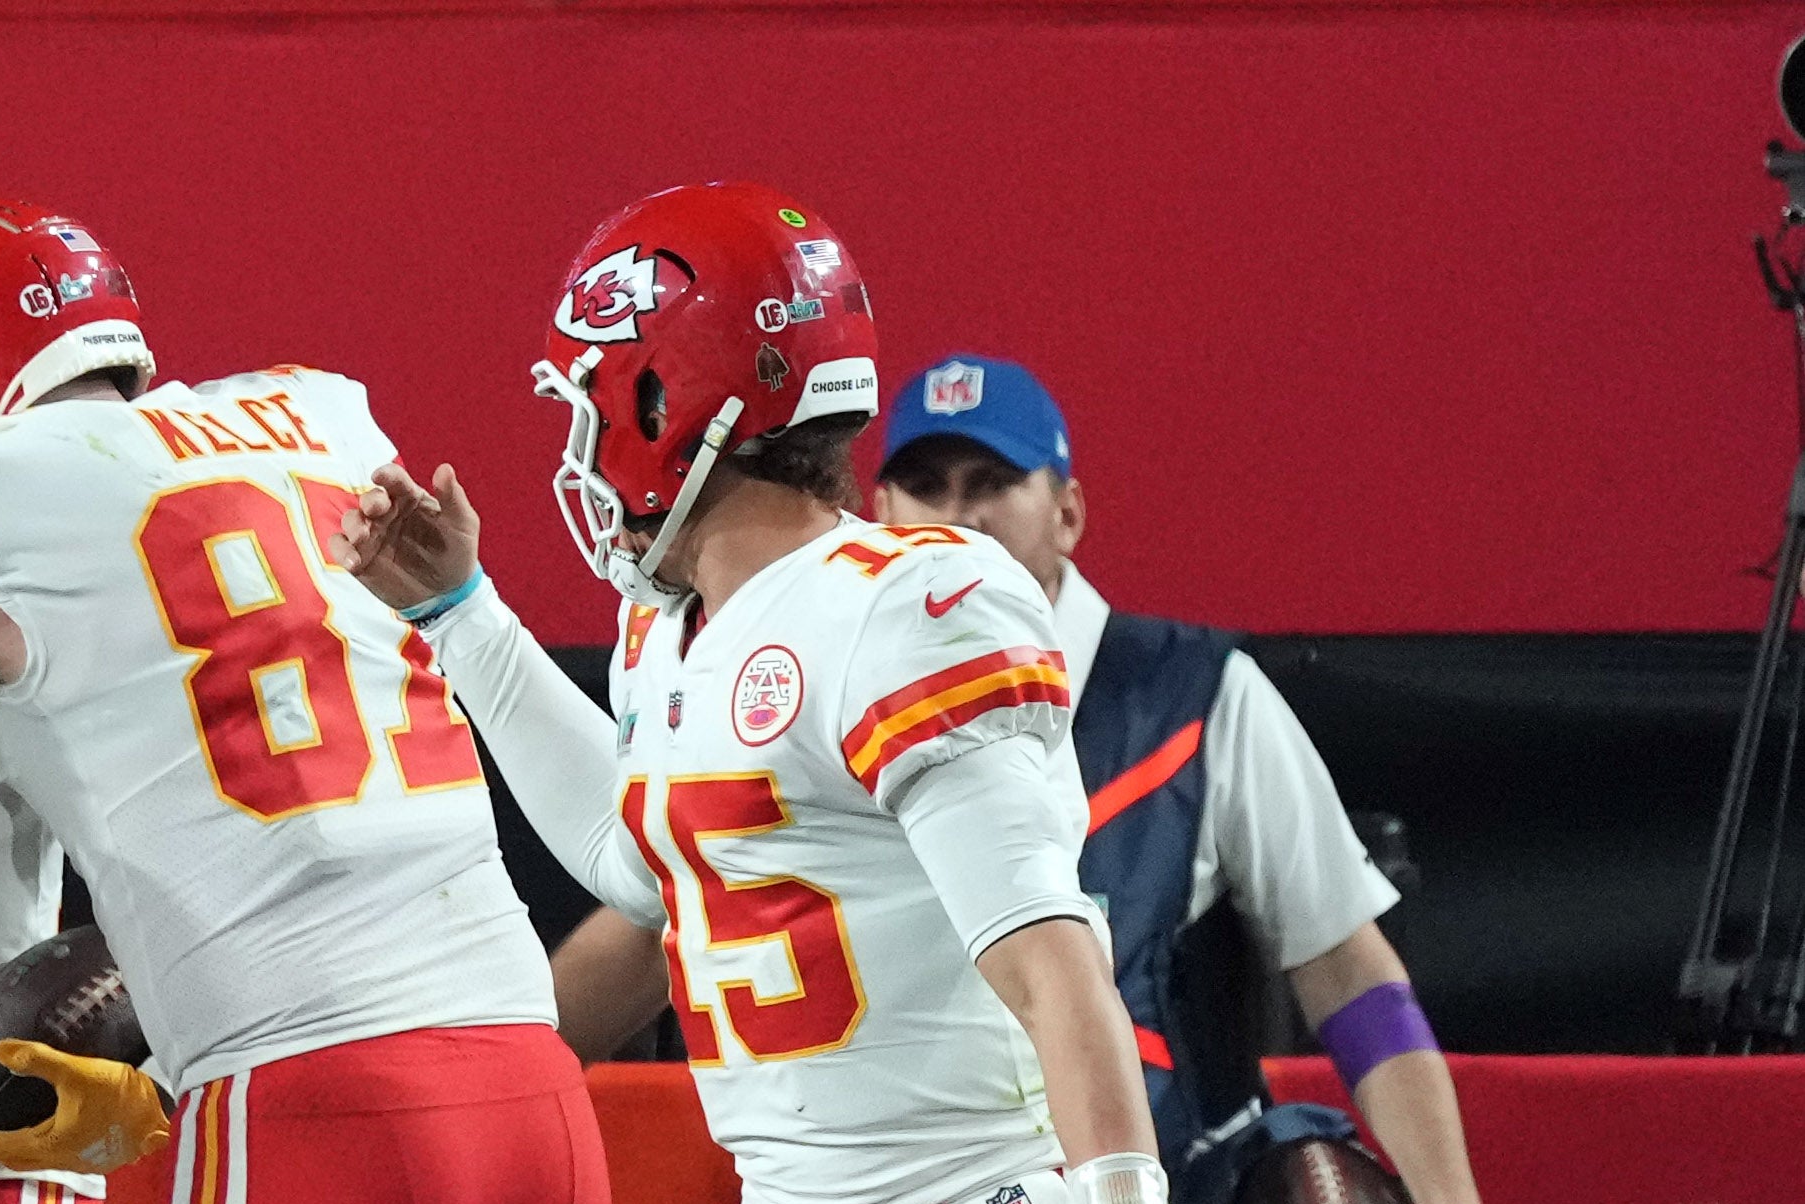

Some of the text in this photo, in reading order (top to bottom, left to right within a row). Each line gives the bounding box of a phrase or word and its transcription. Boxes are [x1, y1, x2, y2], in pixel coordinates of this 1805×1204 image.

[24, 287, 49, 314] 16
[760, 303, 785, 328] 16
[811, 379, 853, 394] CHOOSE
[134, 387, 331, 463] KELCE
[132, 470, 488, 825] 87
[619, 768, 868, 1069] 15
